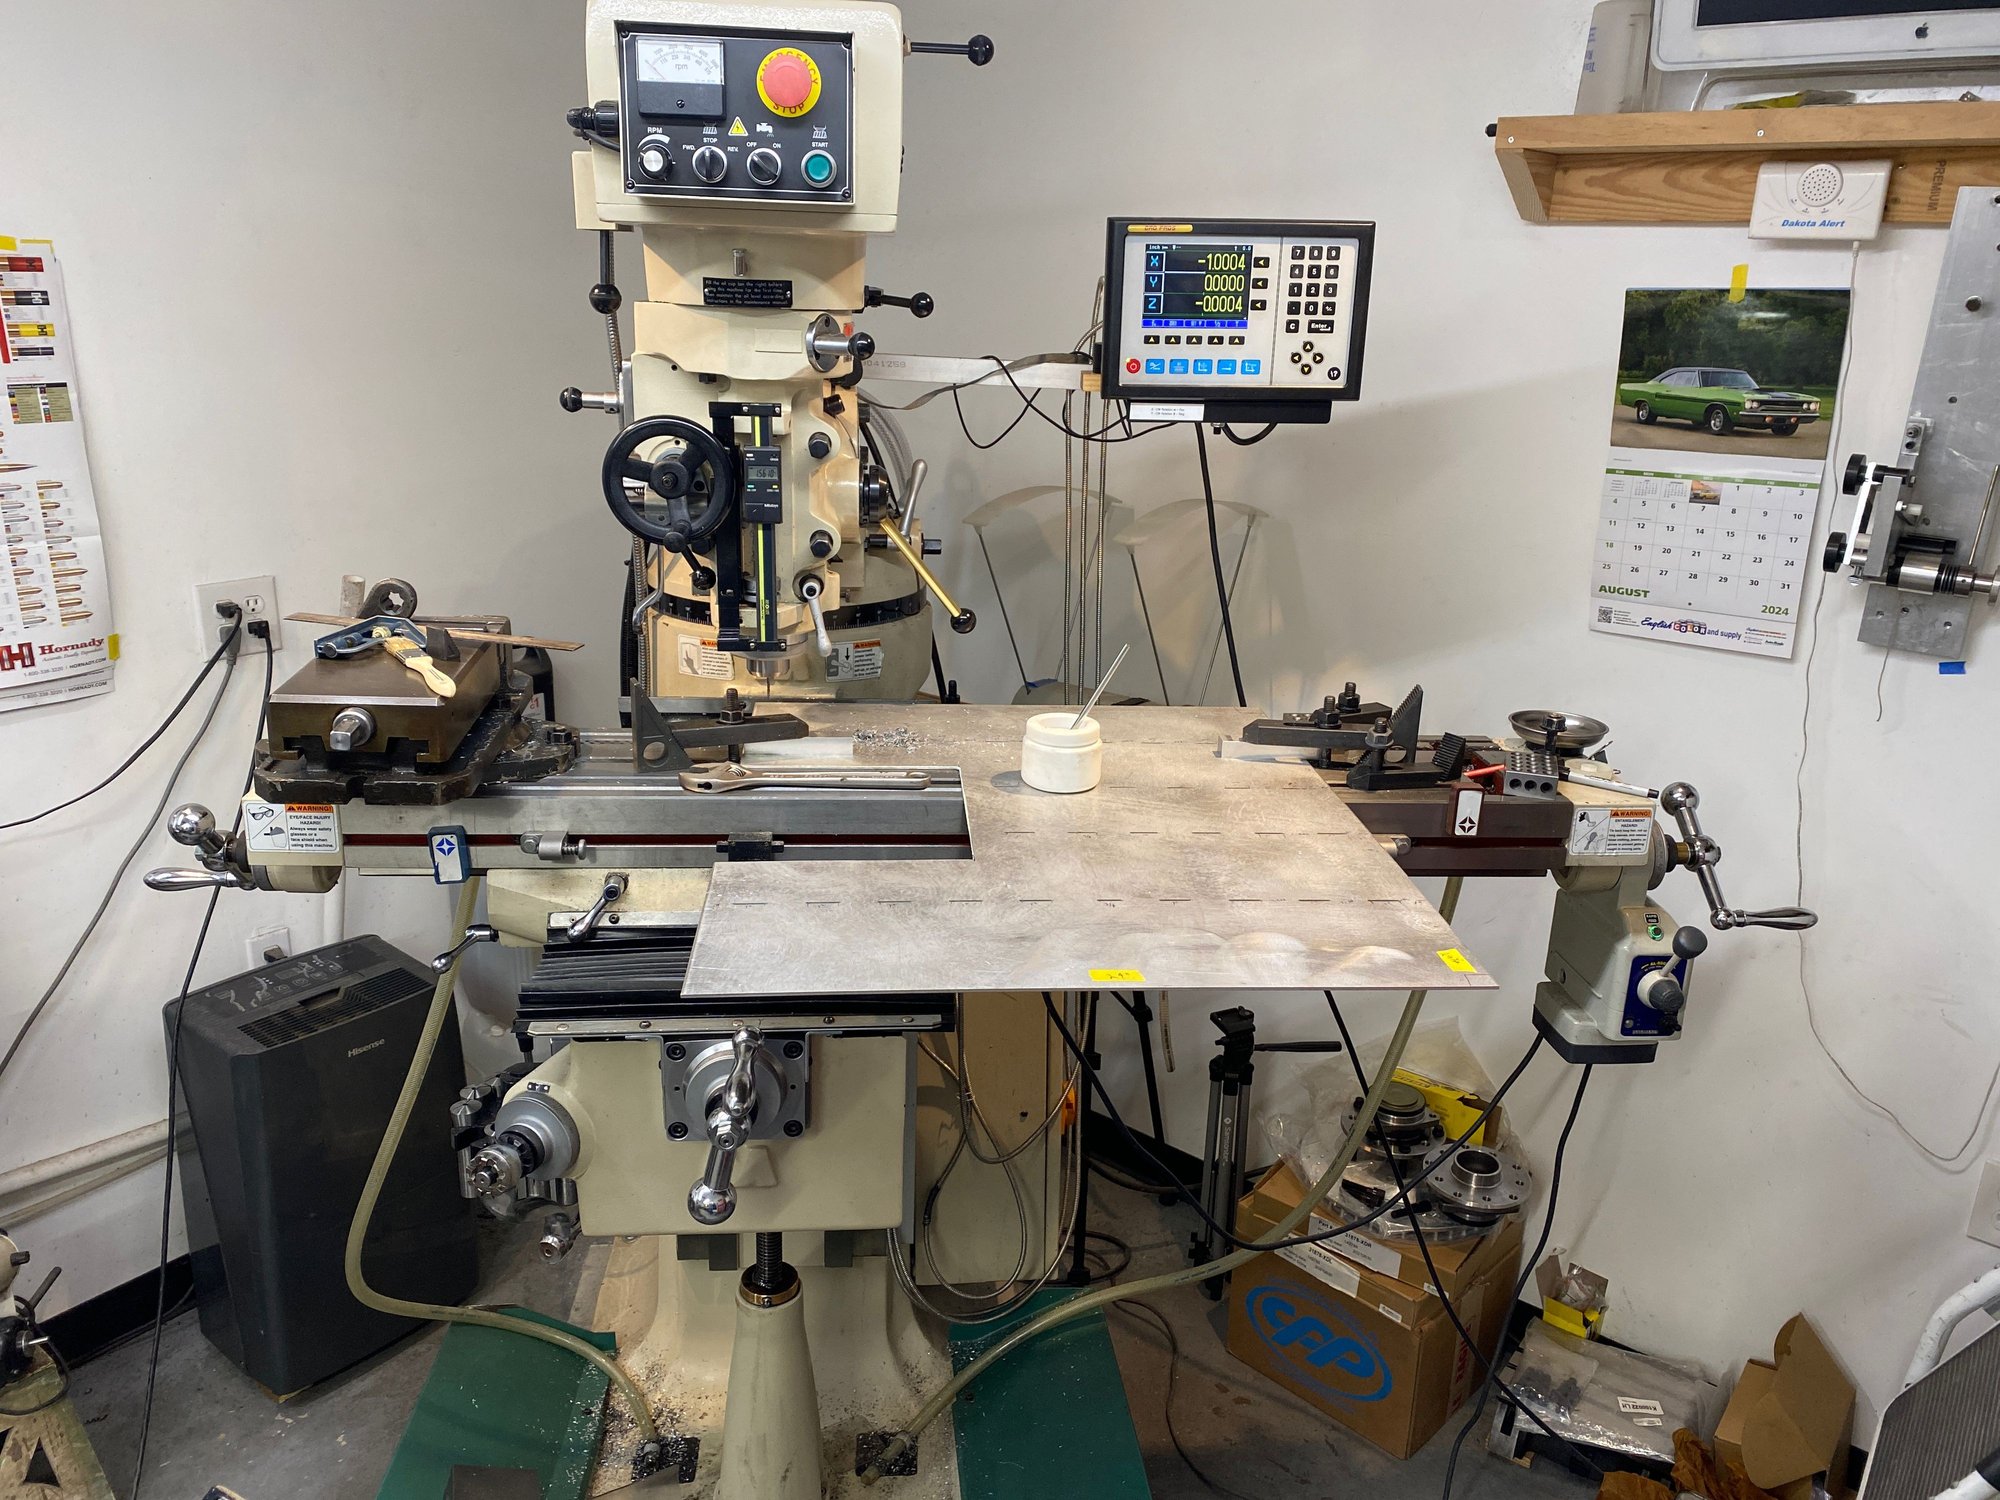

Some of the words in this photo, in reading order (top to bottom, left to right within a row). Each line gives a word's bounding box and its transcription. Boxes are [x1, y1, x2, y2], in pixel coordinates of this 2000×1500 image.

[1927, 160, 1946, 212] PREMIUM
[1819, 219, 1845, 228] Alert
[1150, 255, 1159, 267] X
[1198, 253, 1246, 271] -1.0004
[1149, 276, 1158, 288] Y
[1204, 274, 1245, 292] 0.0000
[1148, 298, 1157, 309] Z
[1195, 295, 1243, 312] -0.0004
[1598, 584, 1650, 598] AUGUST
[1761, 604, 1790, 616] 2024
[1641, 617, 1672, 630] English
[1673, 622, 1707, 634] COLOR
[1720, 631, 1742, 640] supply
[39, 638, 105, 655] Hornady
[69, 657, 107, 669] HORNADY.COM
[68, 681, 108, 692] HORNADY.COM
[348, 1039, 385, 1058] Hisense
